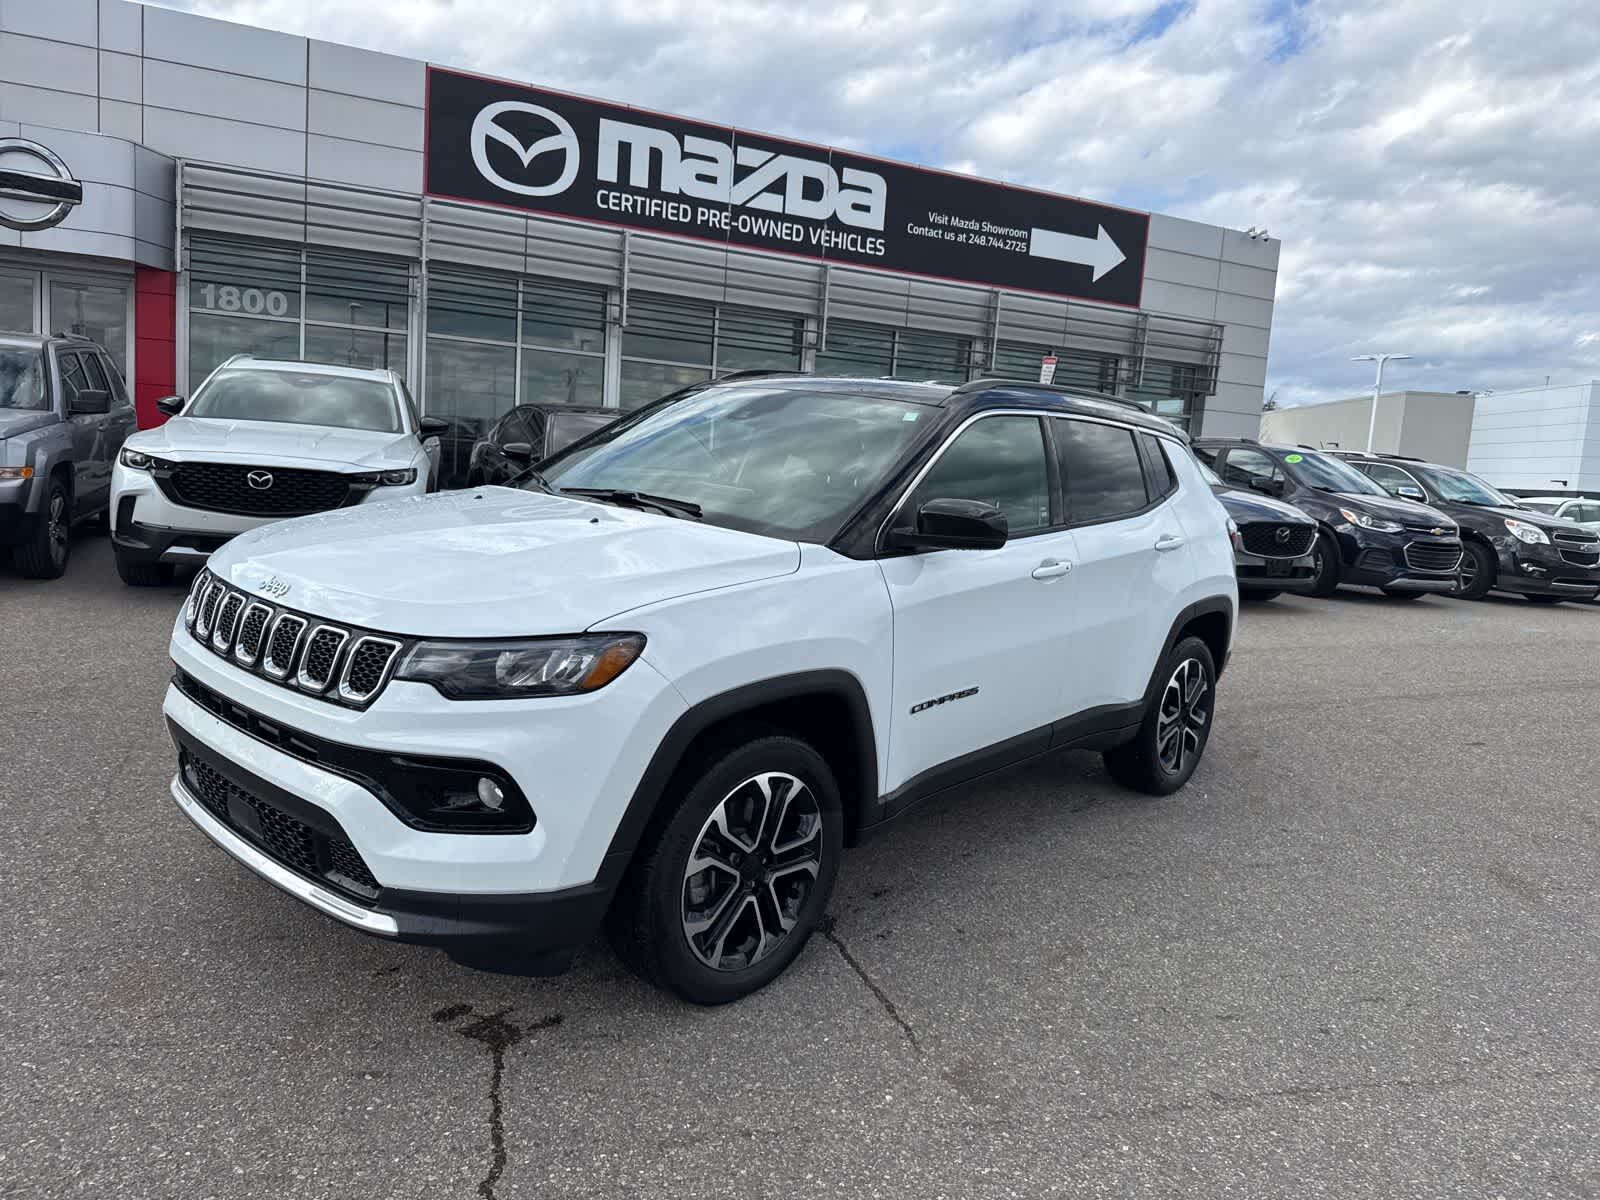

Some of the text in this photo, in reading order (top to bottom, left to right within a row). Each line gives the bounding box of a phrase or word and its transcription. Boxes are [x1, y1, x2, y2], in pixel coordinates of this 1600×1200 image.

[596, 189, 886, 256] CERTIFIED PRE-OWNED VEHICLES
[928, 211, 1029, 239] Visit Mazda Showroom
[907, 223, 1028, 253] Contact us at 248.744.2725
[200, 283, 288, 316] 1800
[258, 575, 292, 599] Jeep
[909, 685, 980, 715] COMPASS
